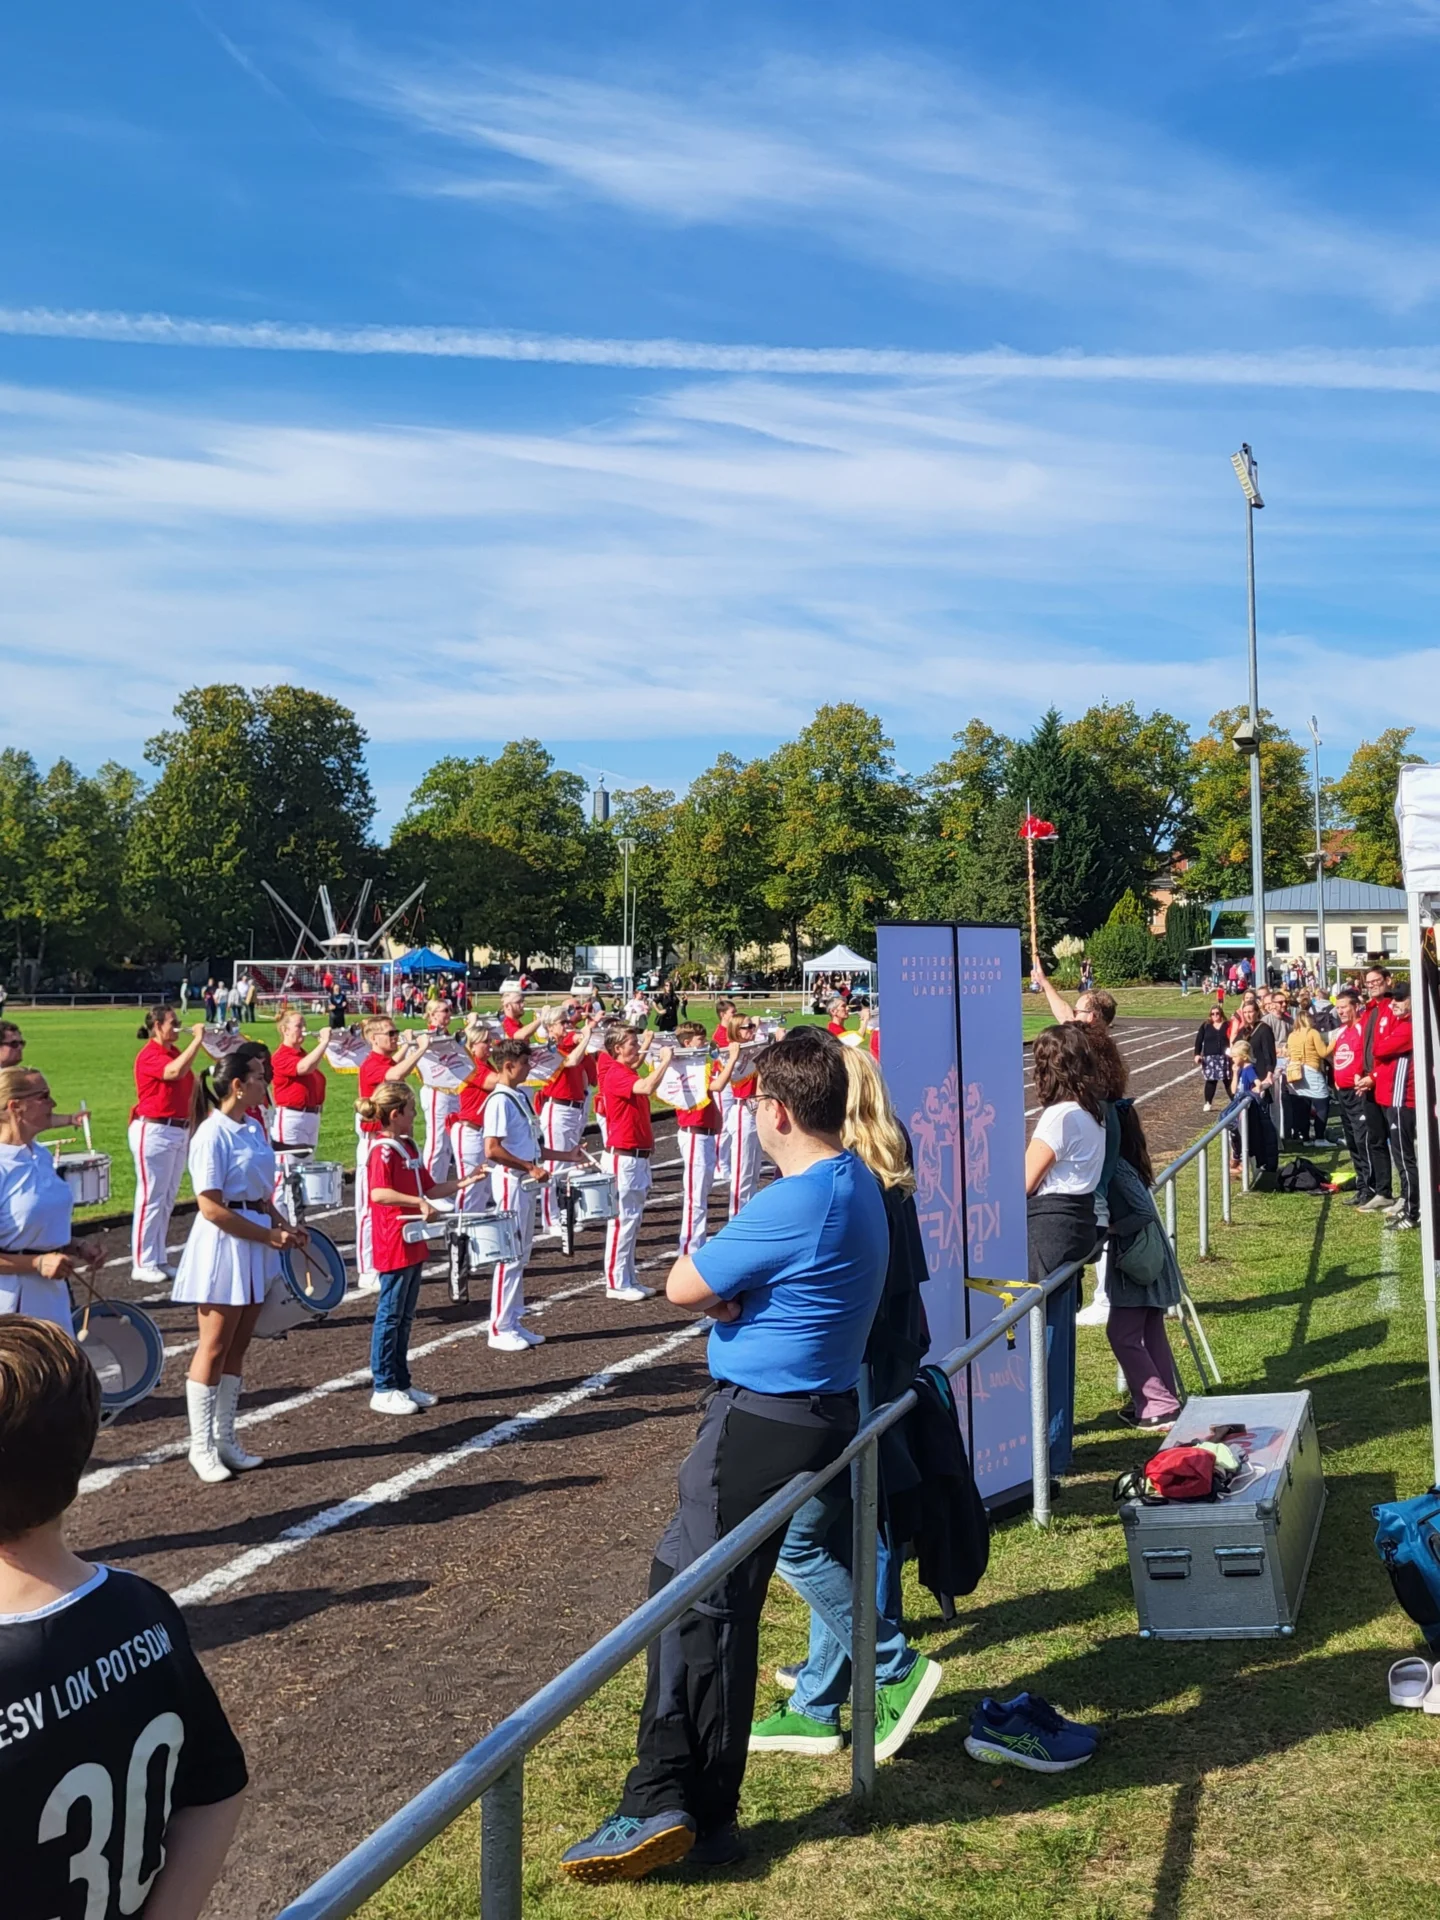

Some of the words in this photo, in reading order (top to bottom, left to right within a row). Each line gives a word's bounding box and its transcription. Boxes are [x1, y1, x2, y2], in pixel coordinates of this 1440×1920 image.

[0, 1691, 45, 1750] ESV
[50, 1666, 98, 1720] LOK
[38, 1711, 186, 1920] 30
